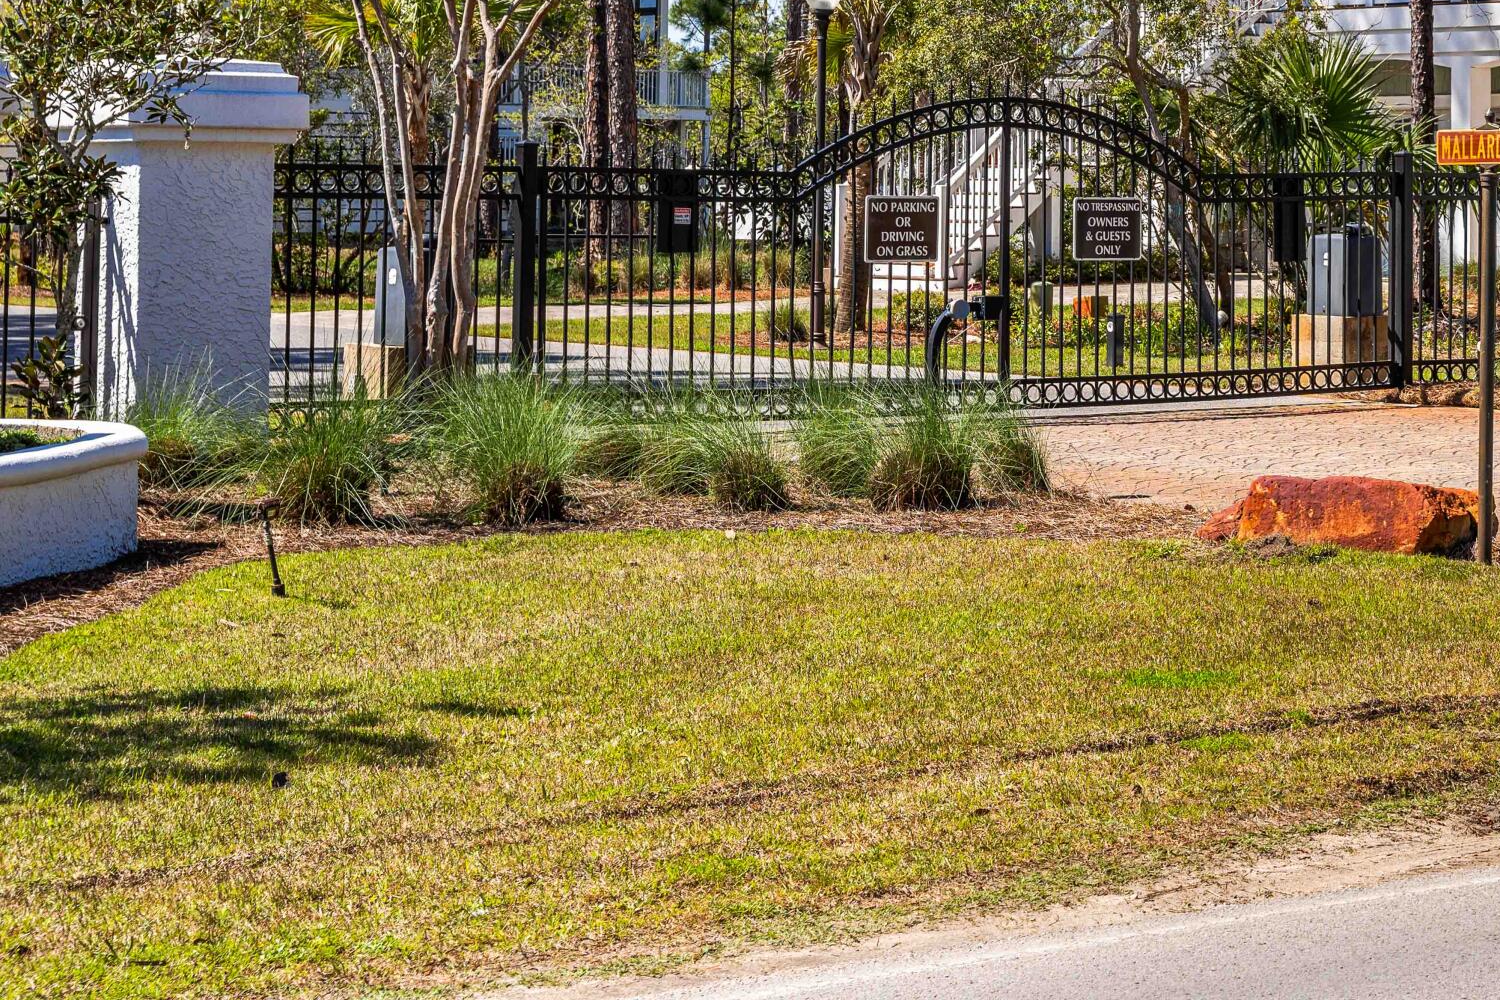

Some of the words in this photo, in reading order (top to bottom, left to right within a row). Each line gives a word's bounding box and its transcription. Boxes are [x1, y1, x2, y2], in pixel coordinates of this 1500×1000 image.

[871, 202, 888, 213] NO
[890, 202, 935, 213] PARKING
[1077, 202, 1090, 212] NO
[1091, 202, 1140, 212] TRESPASSING
[895, 216, 911, 228] OR
[1087, 216, 1129, 227] OWNERS
[881, 231, 925, 242] DRIVING
[1085, 230, 1094, 241] &
[1095, 230, 1131, 241] GUESTS
[876, 245, 894, 257] ON
[896, 245, 928, 257] GRASS
[1095, 244, 1122, 255] ONLY
